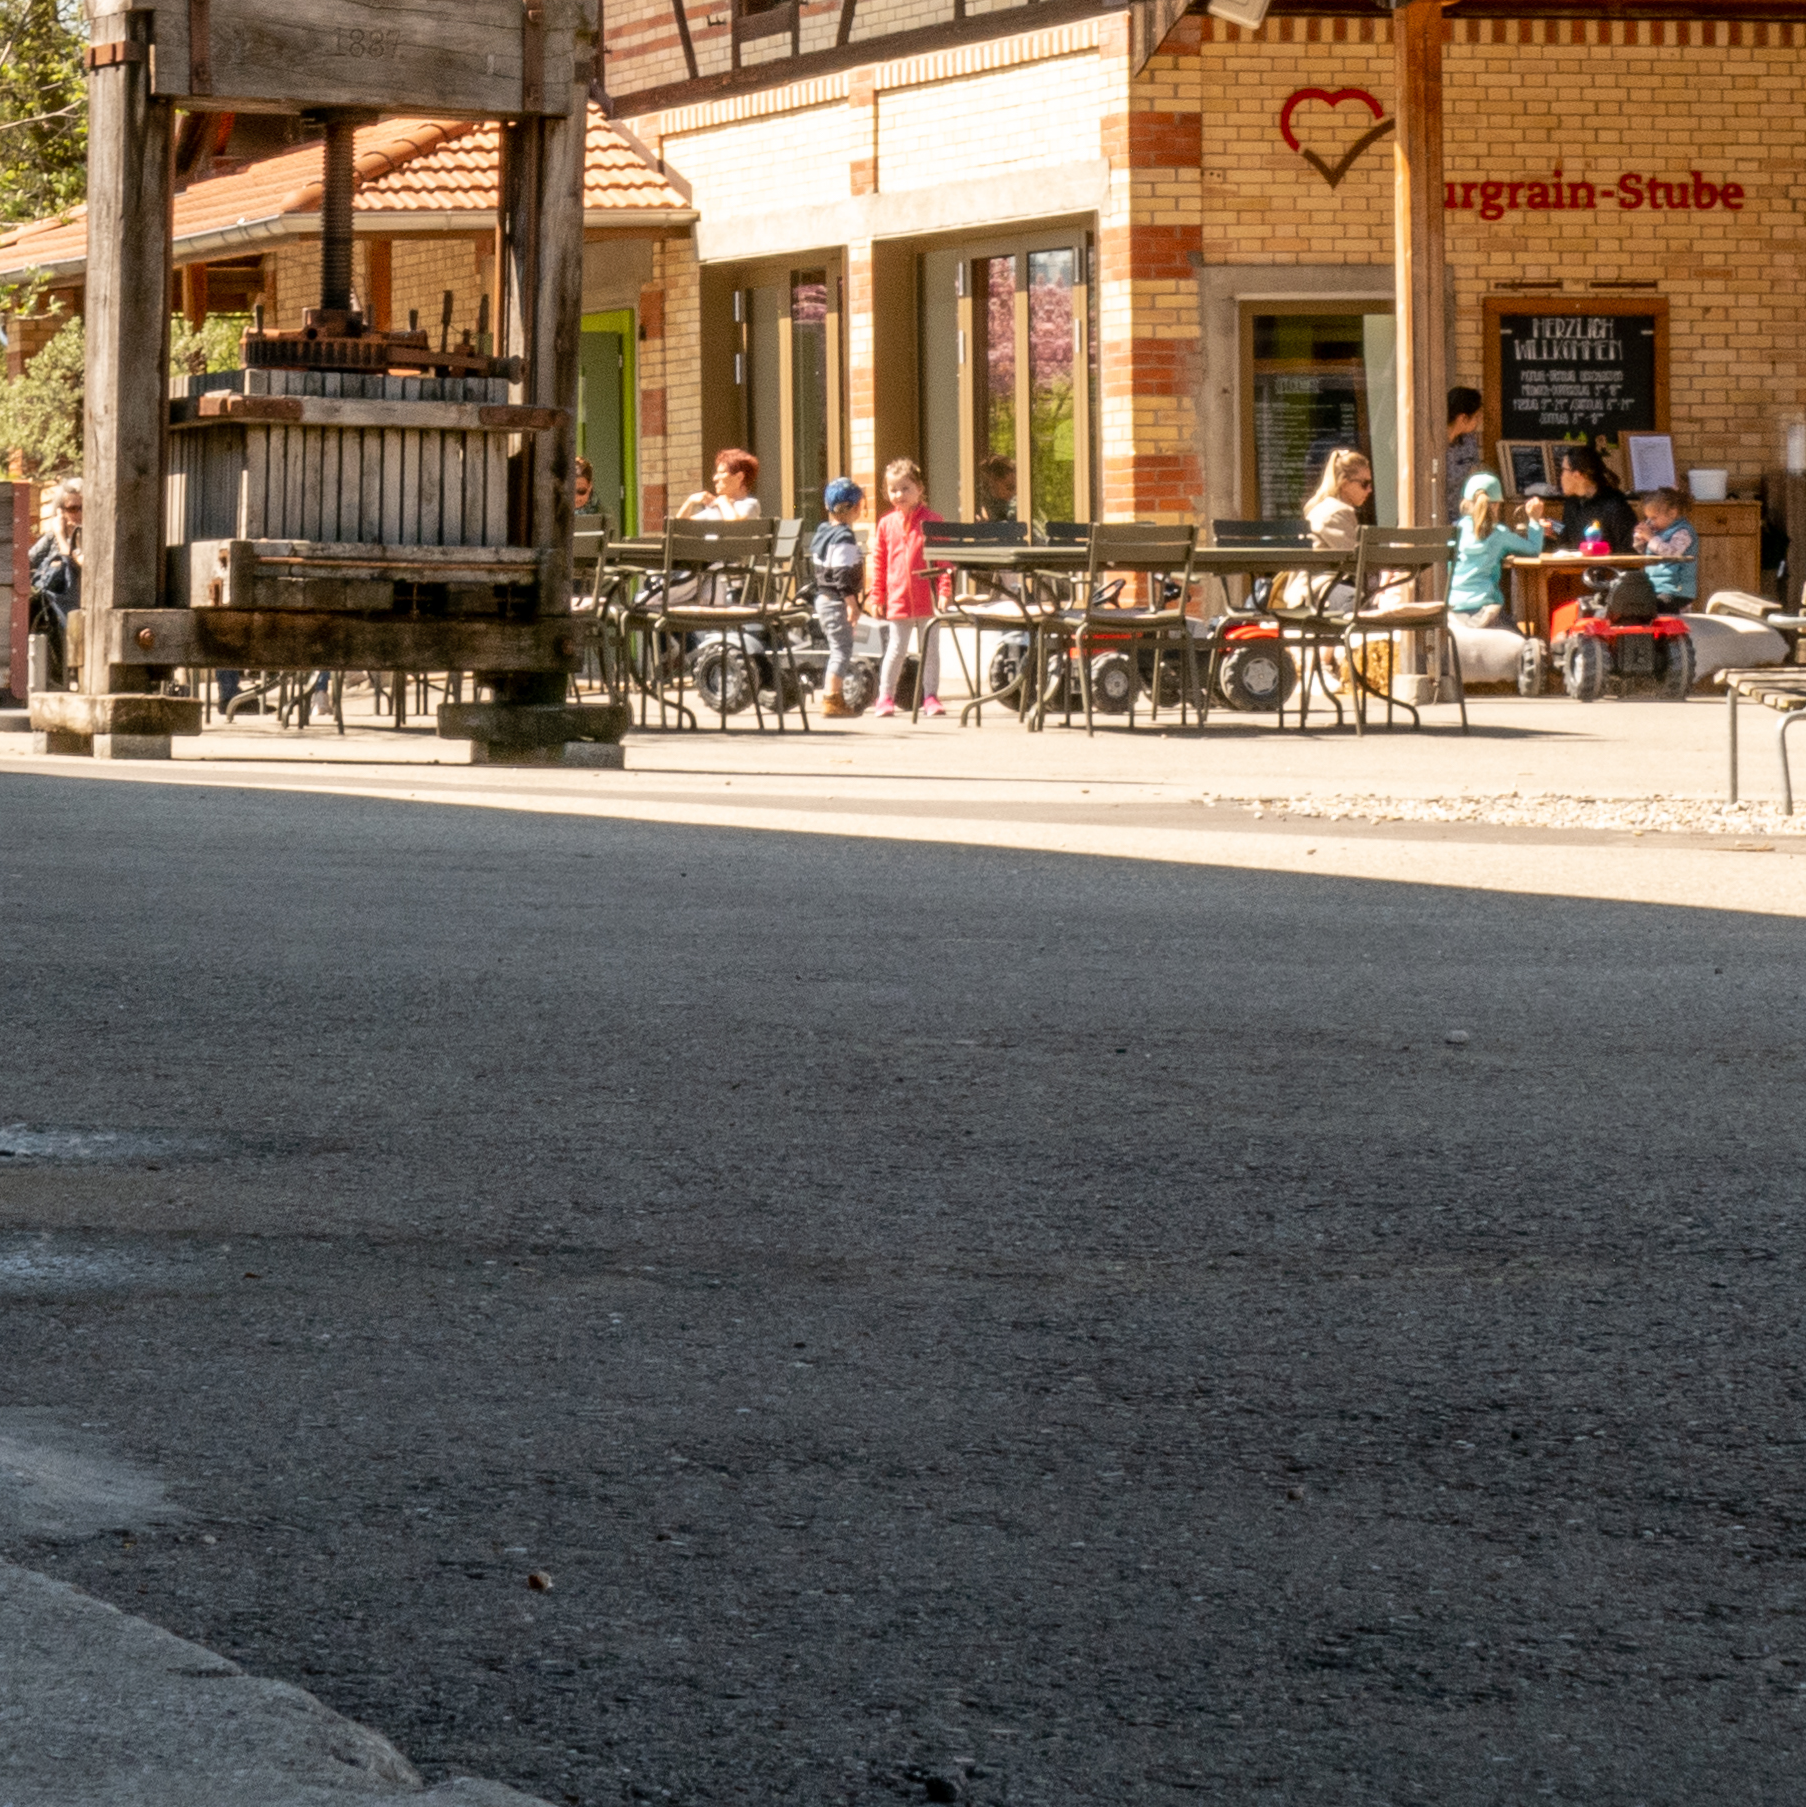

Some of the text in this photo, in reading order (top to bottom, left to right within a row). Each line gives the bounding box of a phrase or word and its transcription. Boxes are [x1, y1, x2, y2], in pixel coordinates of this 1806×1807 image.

[1444, 170, 1744, 220] urgrain-Stube
[1532, 318, 1614, 338] HERZLICH
[1514, 340, 1623, 360] WILLKOMMEN
